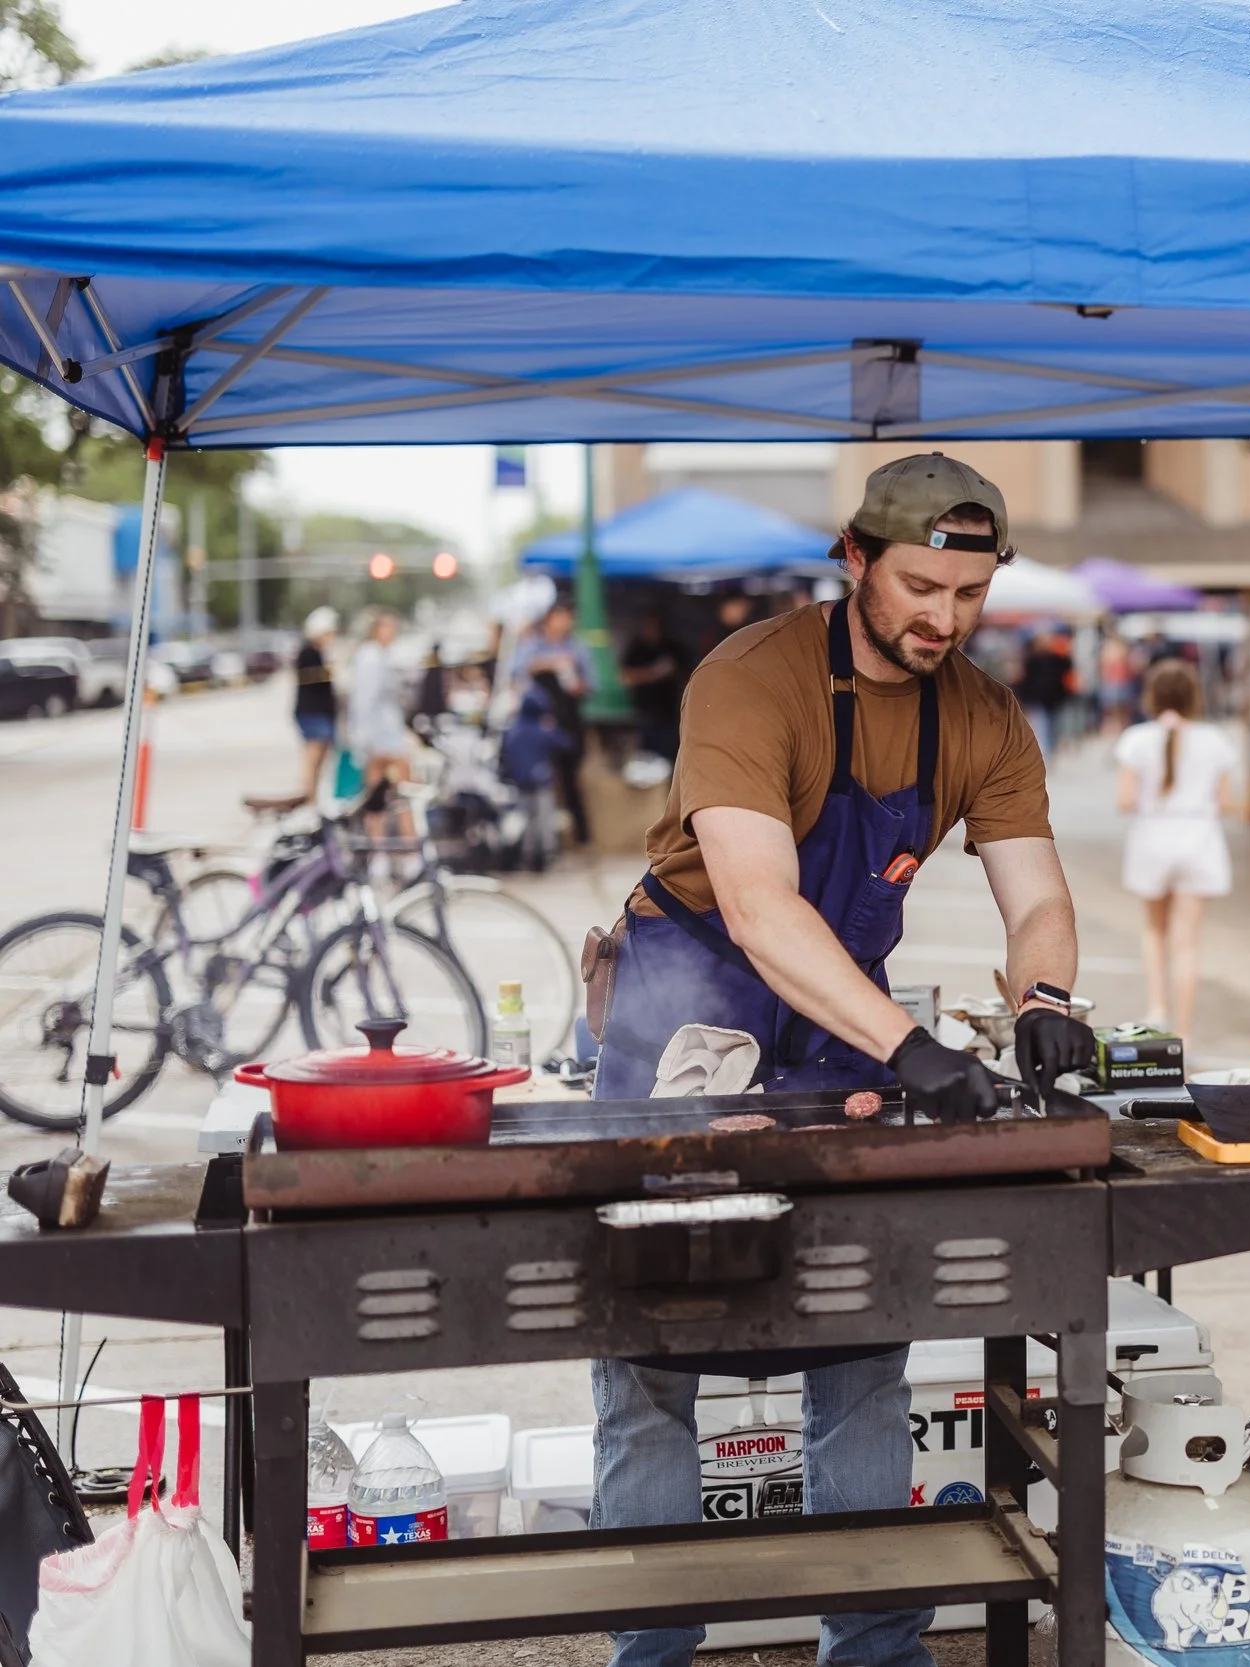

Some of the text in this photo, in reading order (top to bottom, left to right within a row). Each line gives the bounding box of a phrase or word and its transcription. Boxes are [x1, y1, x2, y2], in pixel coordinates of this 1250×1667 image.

[1110, 1066, 1182, 1079] Nitrile Gloves
[715, 1435, 786, 1459] HARPOON
[716, 1455, 787, 1470] BREWERY
[403, 1528, 431, 1540] TEXAS
